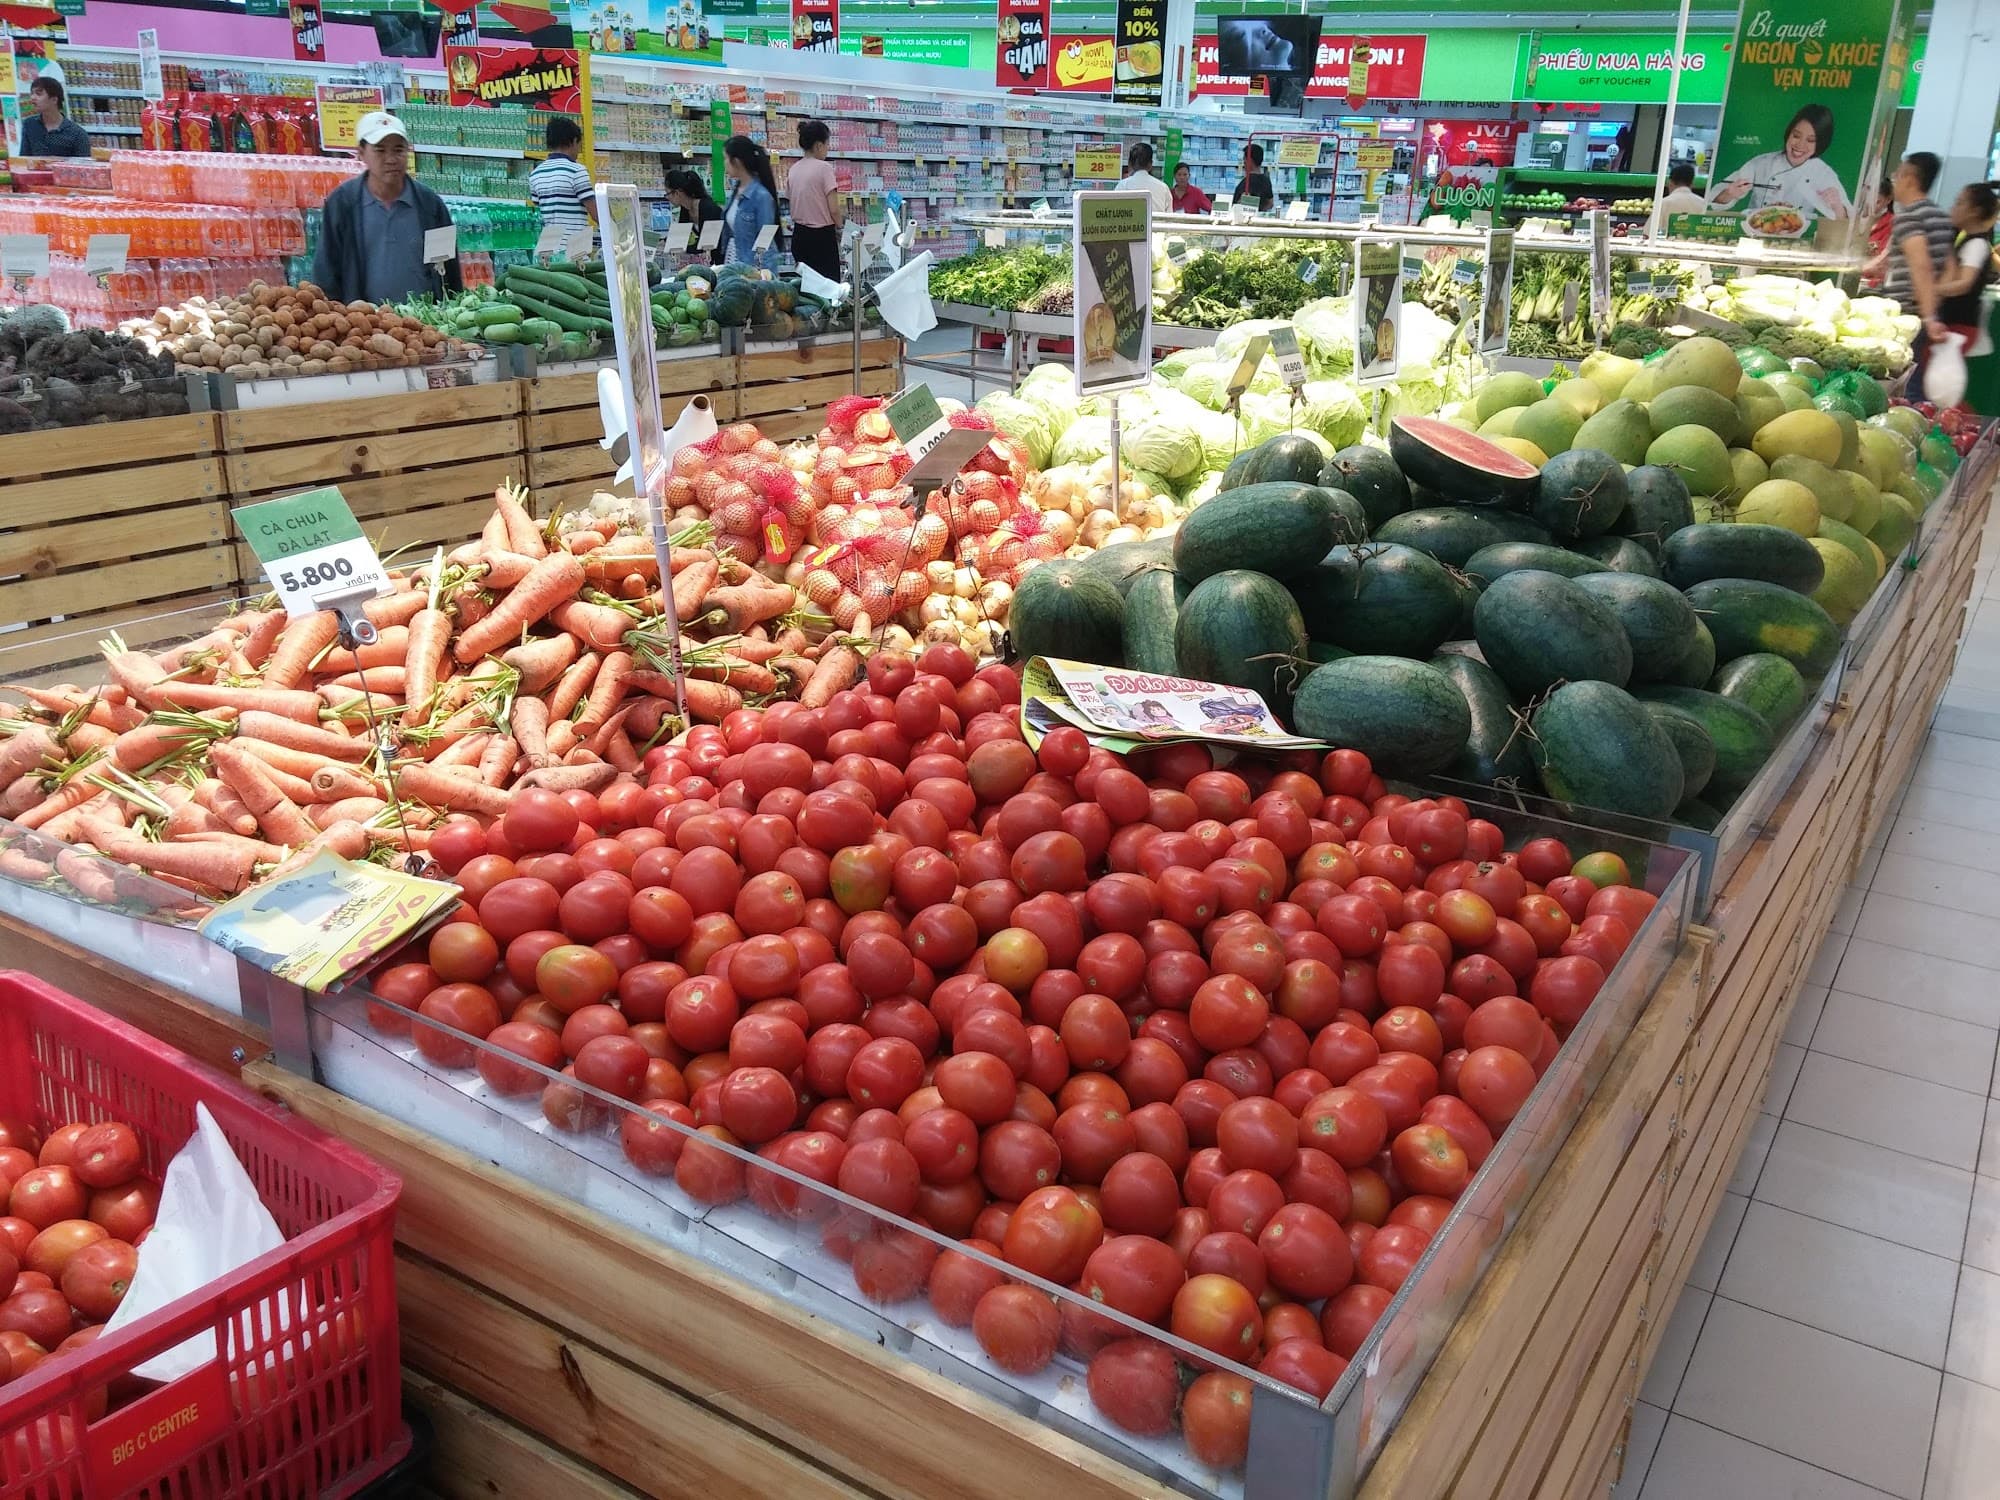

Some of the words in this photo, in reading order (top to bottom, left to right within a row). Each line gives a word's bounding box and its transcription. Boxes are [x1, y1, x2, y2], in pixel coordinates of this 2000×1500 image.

[455, 12, 472, 25] GIÁ
[1133, 6, 1153, 17] ĐẾN
[813, 18, 833, 32] GIÁ
[1021, 19, 1043, 35] GIÁ
[1125, 21, 1159, 37] 10%
[1776, 17, 1828, 45] quyết
[1005, 39, 1047, 74] GIẢM
[1316, 43, 1345, 69] ỆM
[1538, 48, 1592, 71] PHIẾU
[1596, 53, 1638, 70] MUA
[1645, 50, 1705, 71] HÀNG
[1742, 41, 1797, 65] NGON
[480, 69, 542, 100] KHUYẾN
[1196, 75, 1227, 84] EAPER
[1308, 77, 1350, 86] AVINGS
[1578, 77, 1600, 86] GIFT
[1603, 77, 1652, 86] VOUCHER
[1773, 68, 1803, 91] VẸN
[1091, 162, 1104, 172] 28
[1435, 183, 1495, 207] LUÔN
[260, 520, 283, 536] CÀ
[286, 511, 329, 530] CHUA
[278, 537, 302, 553] ĐÀ
[303, 530, 331, 547] LẠT
[280, 557, 353, 592] 5.800
[112, 1439, 135, 1466] BIG
[137, 1432, 147, 1450] C
[149, 1403, 199, 1444] CENTRE
